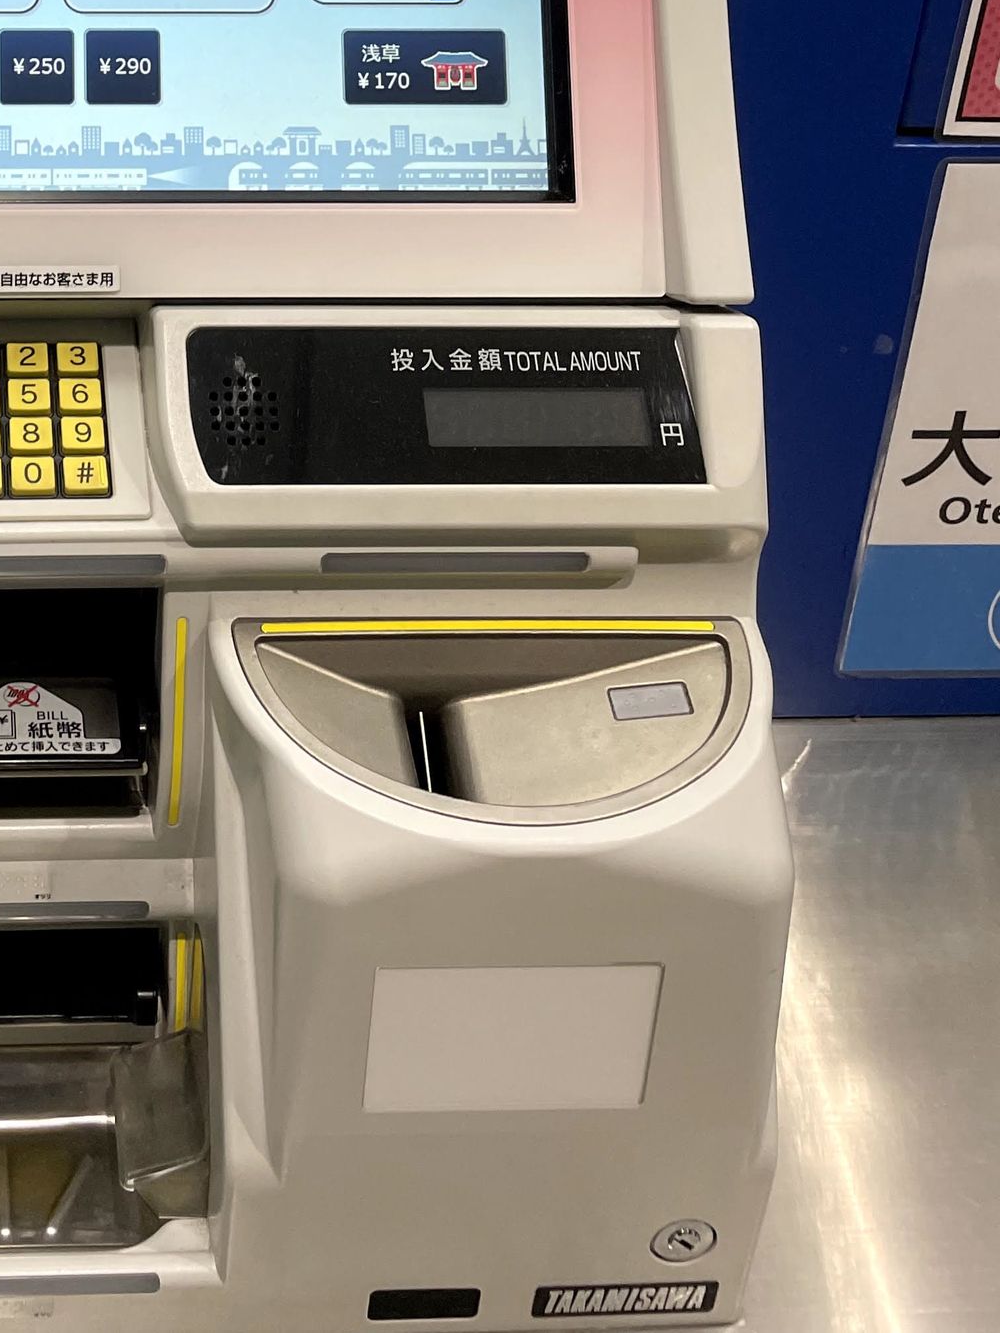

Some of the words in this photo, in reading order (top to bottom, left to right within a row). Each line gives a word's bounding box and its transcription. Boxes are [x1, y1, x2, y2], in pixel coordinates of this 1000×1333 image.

[361, 43, 401, 64] 浅草
[12, 57, 66, 76] ¥250
[99, 57, 153, 76] ¥290
[358, 72, 410, 90] ¥170
[19, 346, 37, 366] 2
[69, 346, 87, 365] 3
[391, 347, 503, 373] 投入金額
[503, 351, 568, 372] TOTAL
[570, 350, 641, 372] AMOUNT
[21, 384, 38, 404] 5
[72, 384, 89, 403] 6
[22, 423, 40, 443] 8
[75, 422, 92, 442] 9
[659, 422, 685, 447] 円
[901, 410, 1000, 487] 大
[24, 463, 42, 484] 0
[36, 710, 70, 721] BILL
[27, 721, 83, 739] 紙幣
[544, 1285, 707, 1314] TAKAMISAWA
